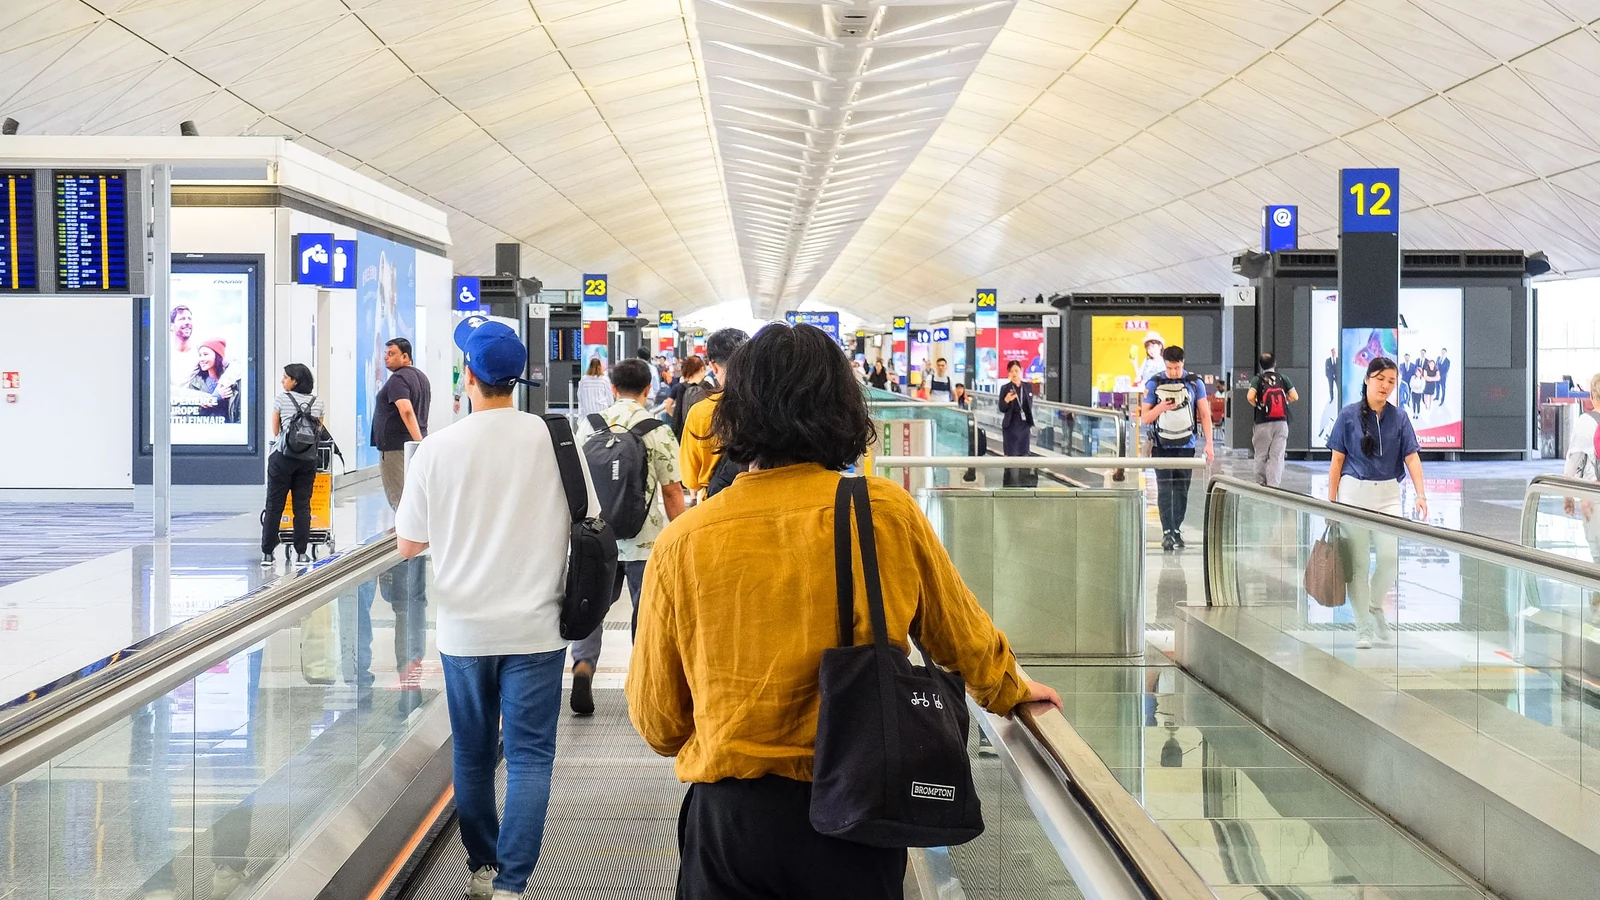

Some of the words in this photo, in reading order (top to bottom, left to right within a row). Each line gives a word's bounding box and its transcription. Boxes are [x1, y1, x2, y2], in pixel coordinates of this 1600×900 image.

[1350, 182, 1391, 216] 12
[585, 279, 607, 296] 23
[977, 292, 995, 307] 24
[659, 312, 673, 324] 25
[170, 396, 218, 406] XPERIENCE
[170, 406, 200, 415] UROPE
[190, 416, 226, 424] FINNAIR
[611, 459, 620, 481] THULE
[914, 785, 952, 797] BROMPTON
